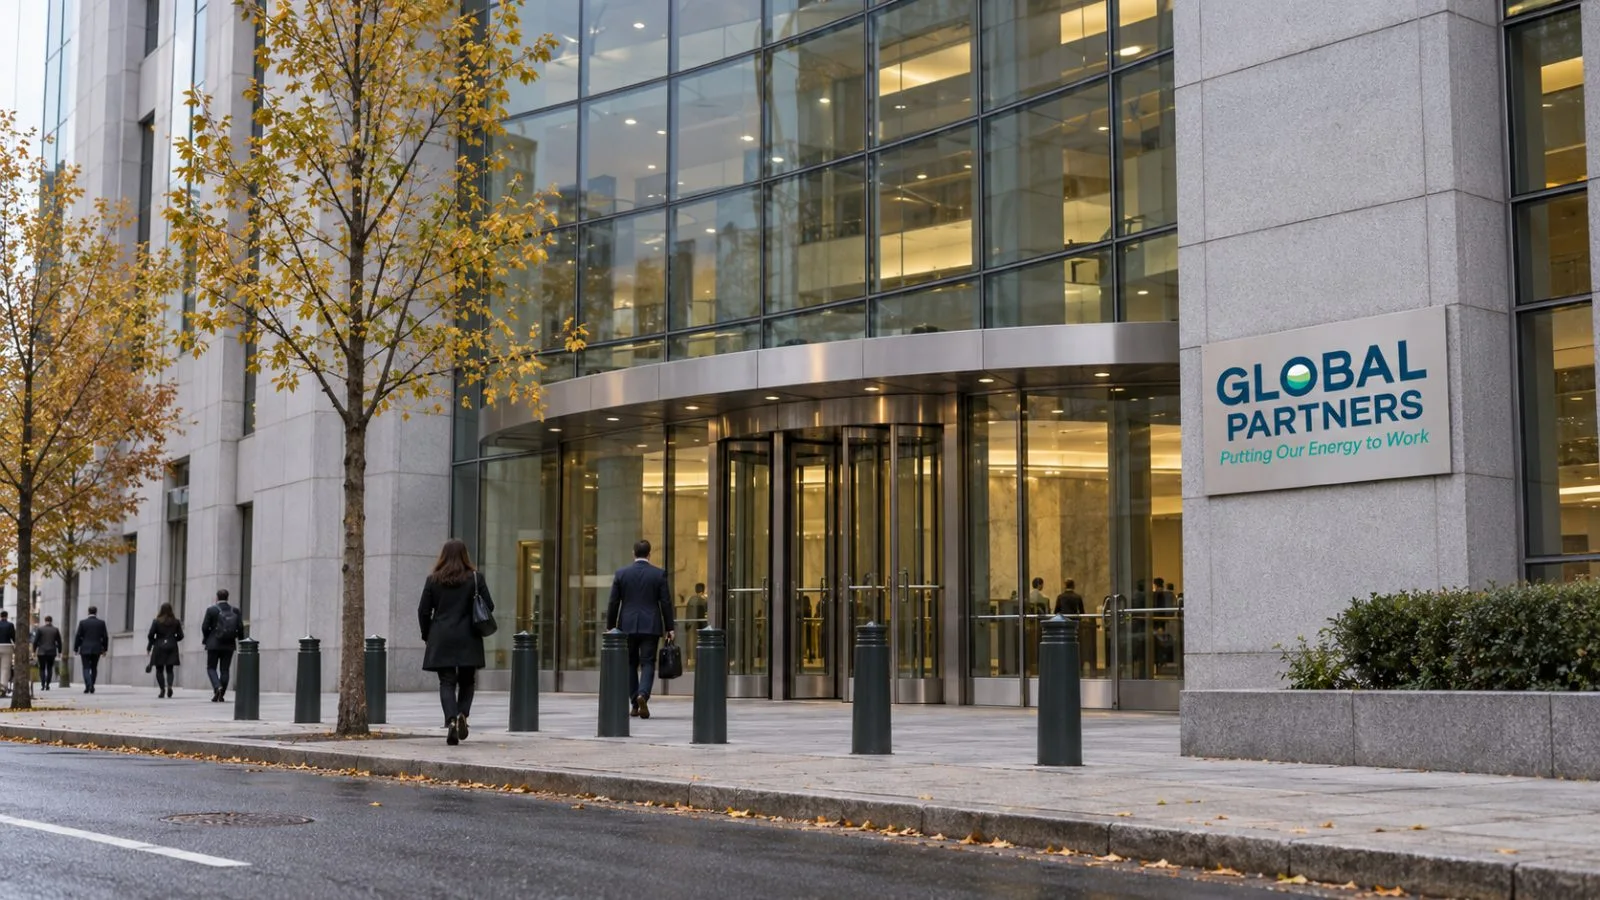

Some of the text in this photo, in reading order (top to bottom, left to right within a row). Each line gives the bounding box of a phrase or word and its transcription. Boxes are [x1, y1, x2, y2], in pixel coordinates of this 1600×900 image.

[1216, 340, 1427, 406] GLOBAL
[1227, 389, 1423, 442] PARTNERS
[1220, 428, 1429, 465] Putting Our Energy to Work
